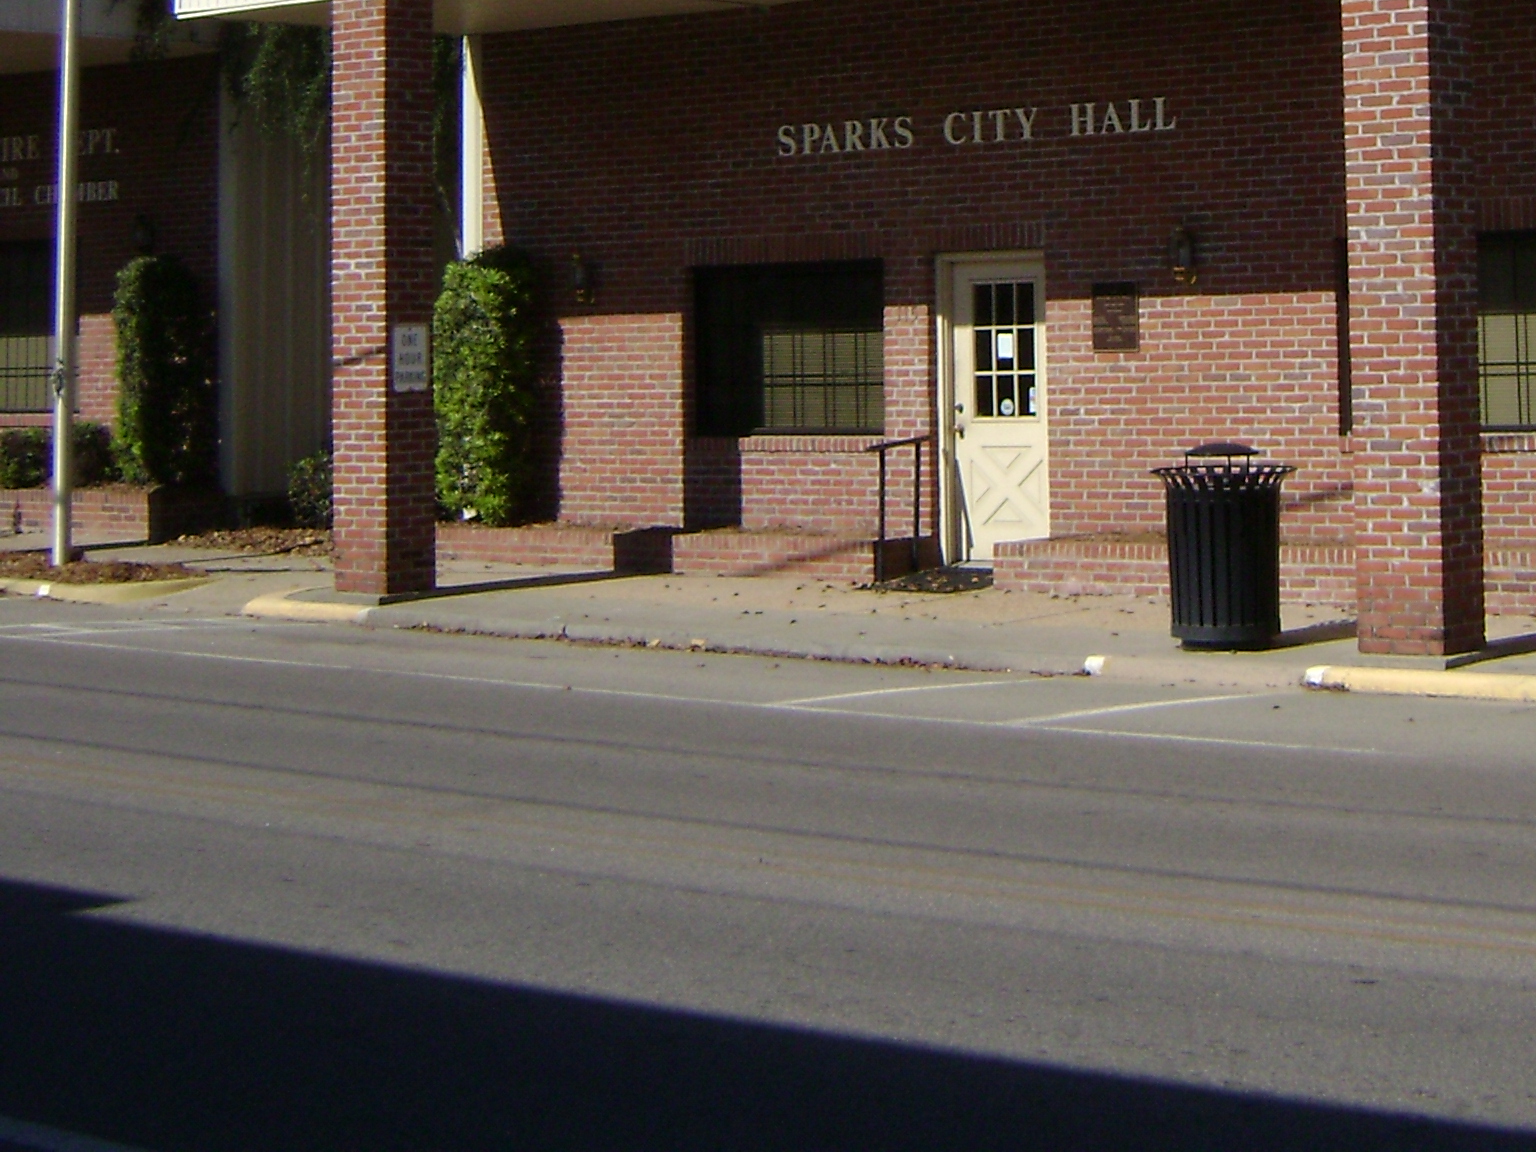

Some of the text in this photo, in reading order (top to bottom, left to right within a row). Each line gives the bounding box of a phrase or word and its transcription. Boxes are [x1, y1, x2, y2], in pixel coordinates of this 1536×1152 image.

[777, 96, 1178, 157] SPARKS CITY HALL
[401, 333, 418, 347] ONE
[398, 351, 423, 366] HOUR
[394, 370, 427, 384] PARKING
